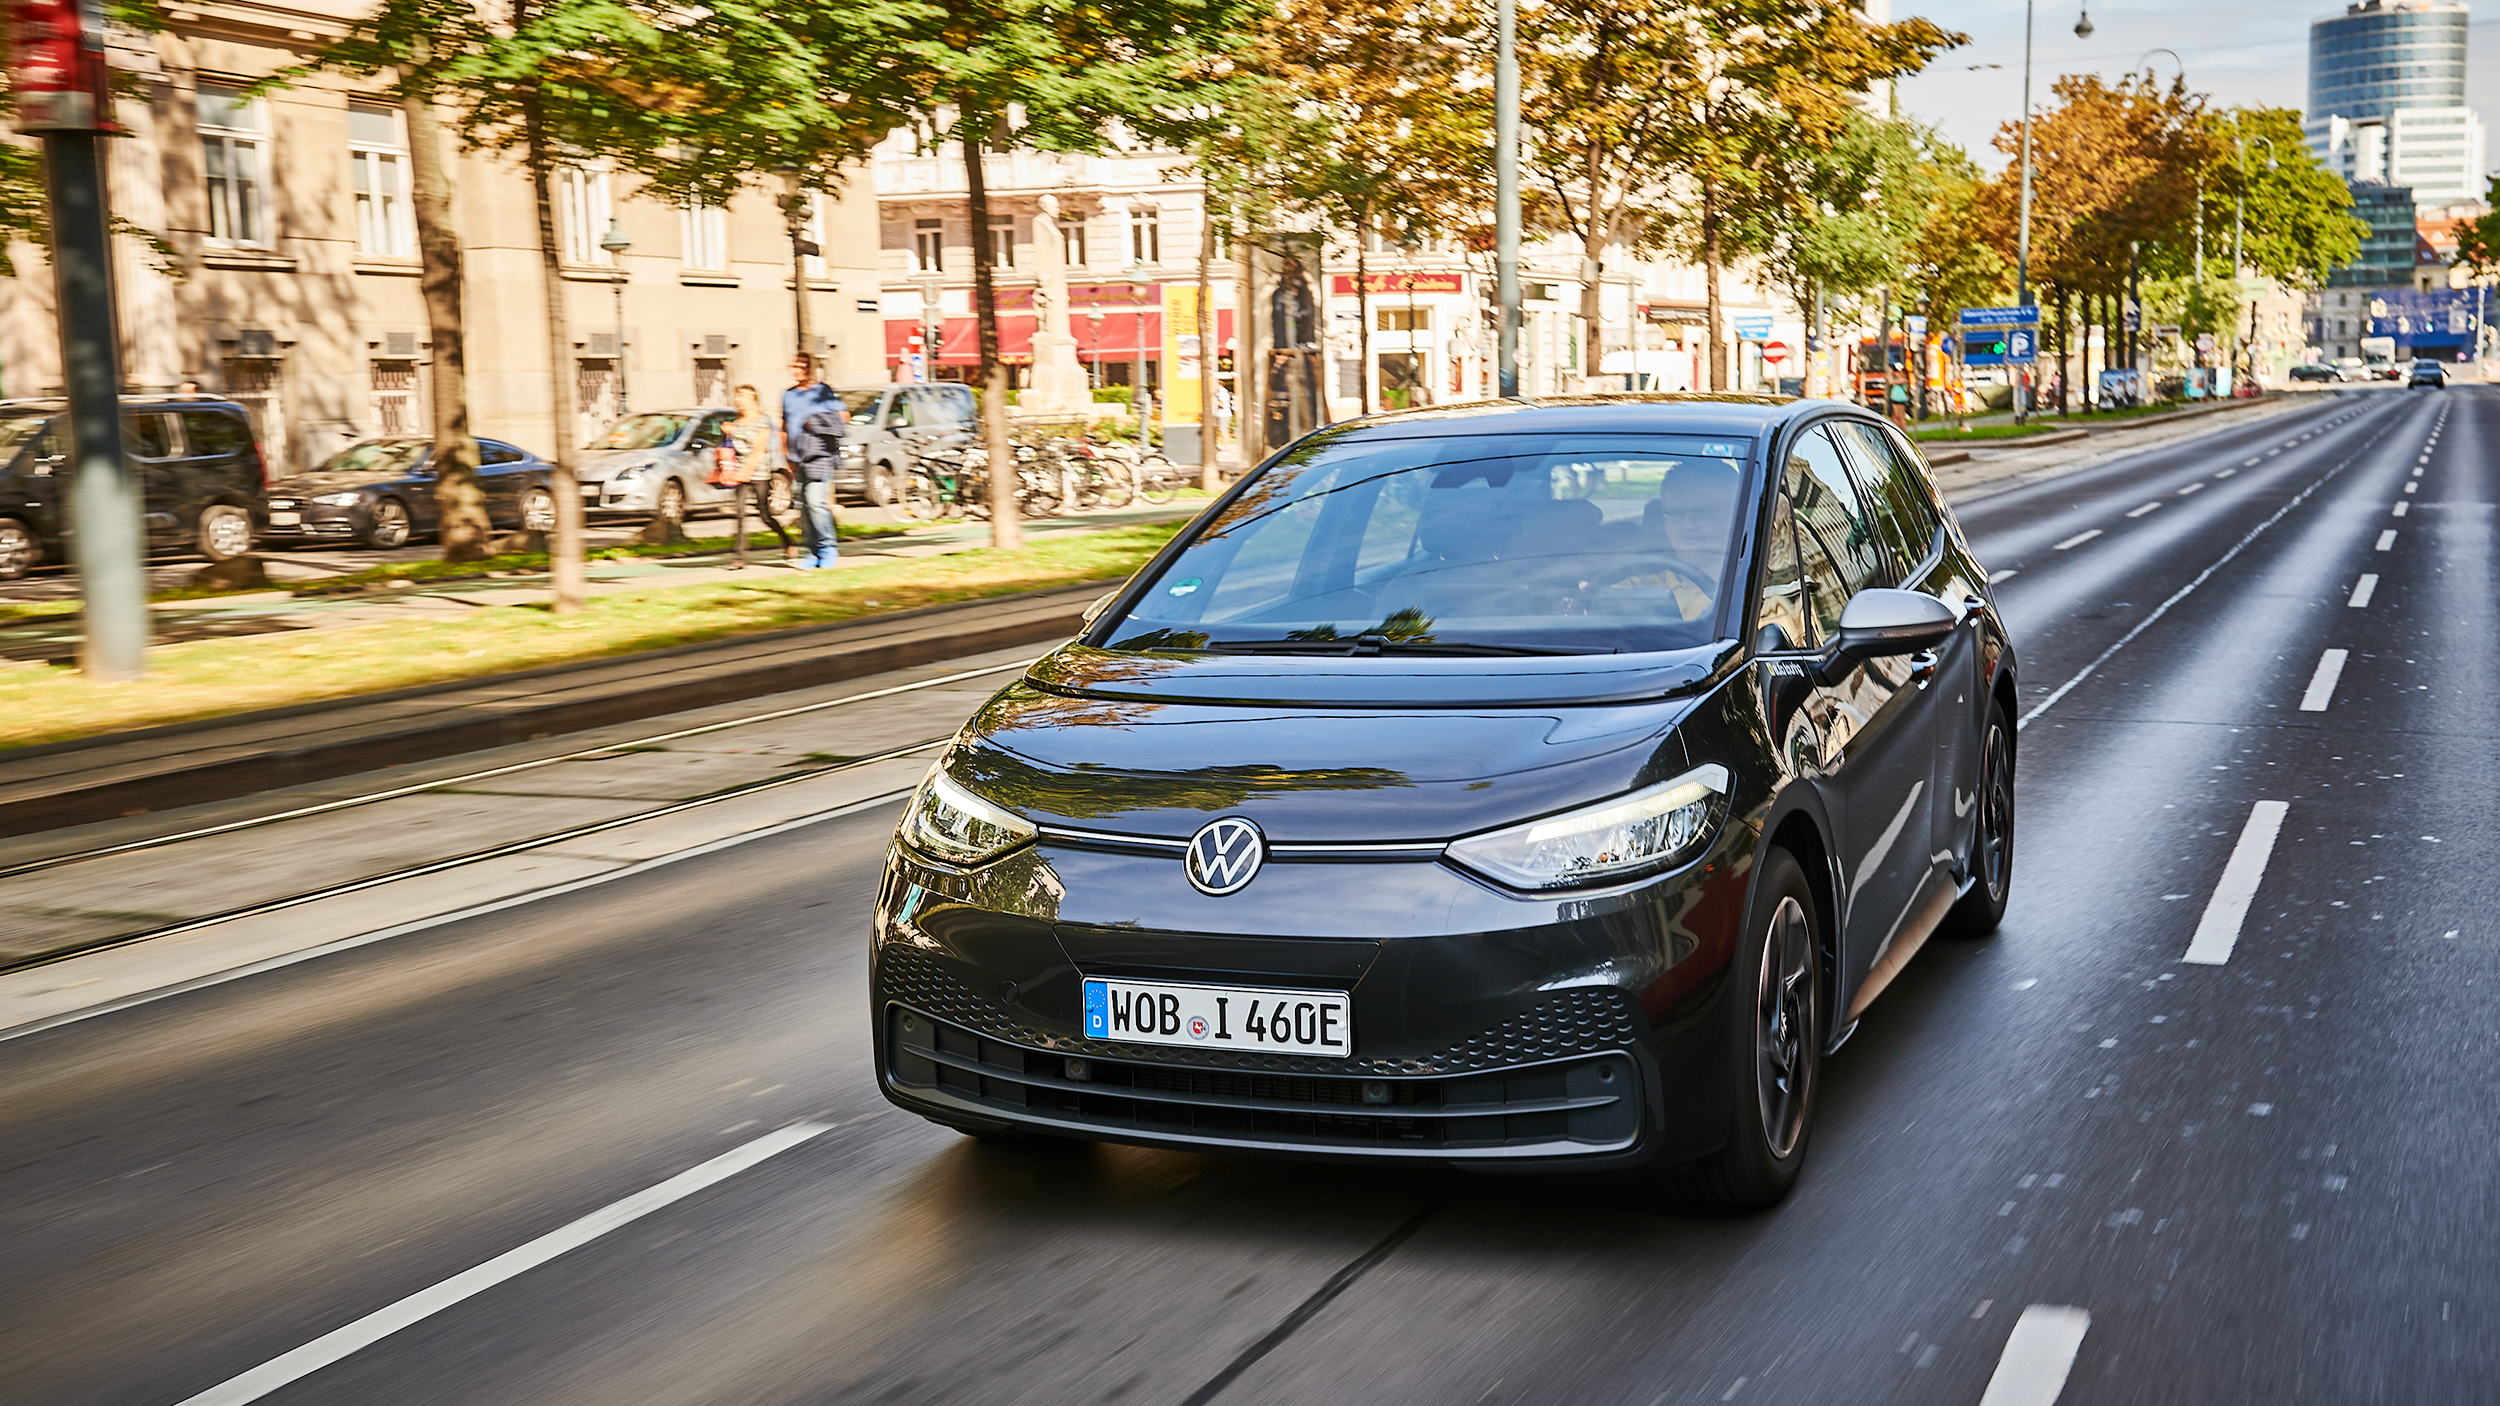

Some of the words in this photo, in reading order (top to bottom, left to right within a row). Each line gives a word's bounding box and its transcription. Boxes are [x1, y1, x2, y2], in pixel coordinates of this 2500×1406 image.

[2011, 338, 2029, 357] P
[1092, 1014, 1102, 1028] D
[1111, 989, 1181, 1036] WOB
[1215, 997, 1232, 1040] I
[1245, 999, 1343, 1046] 460E
